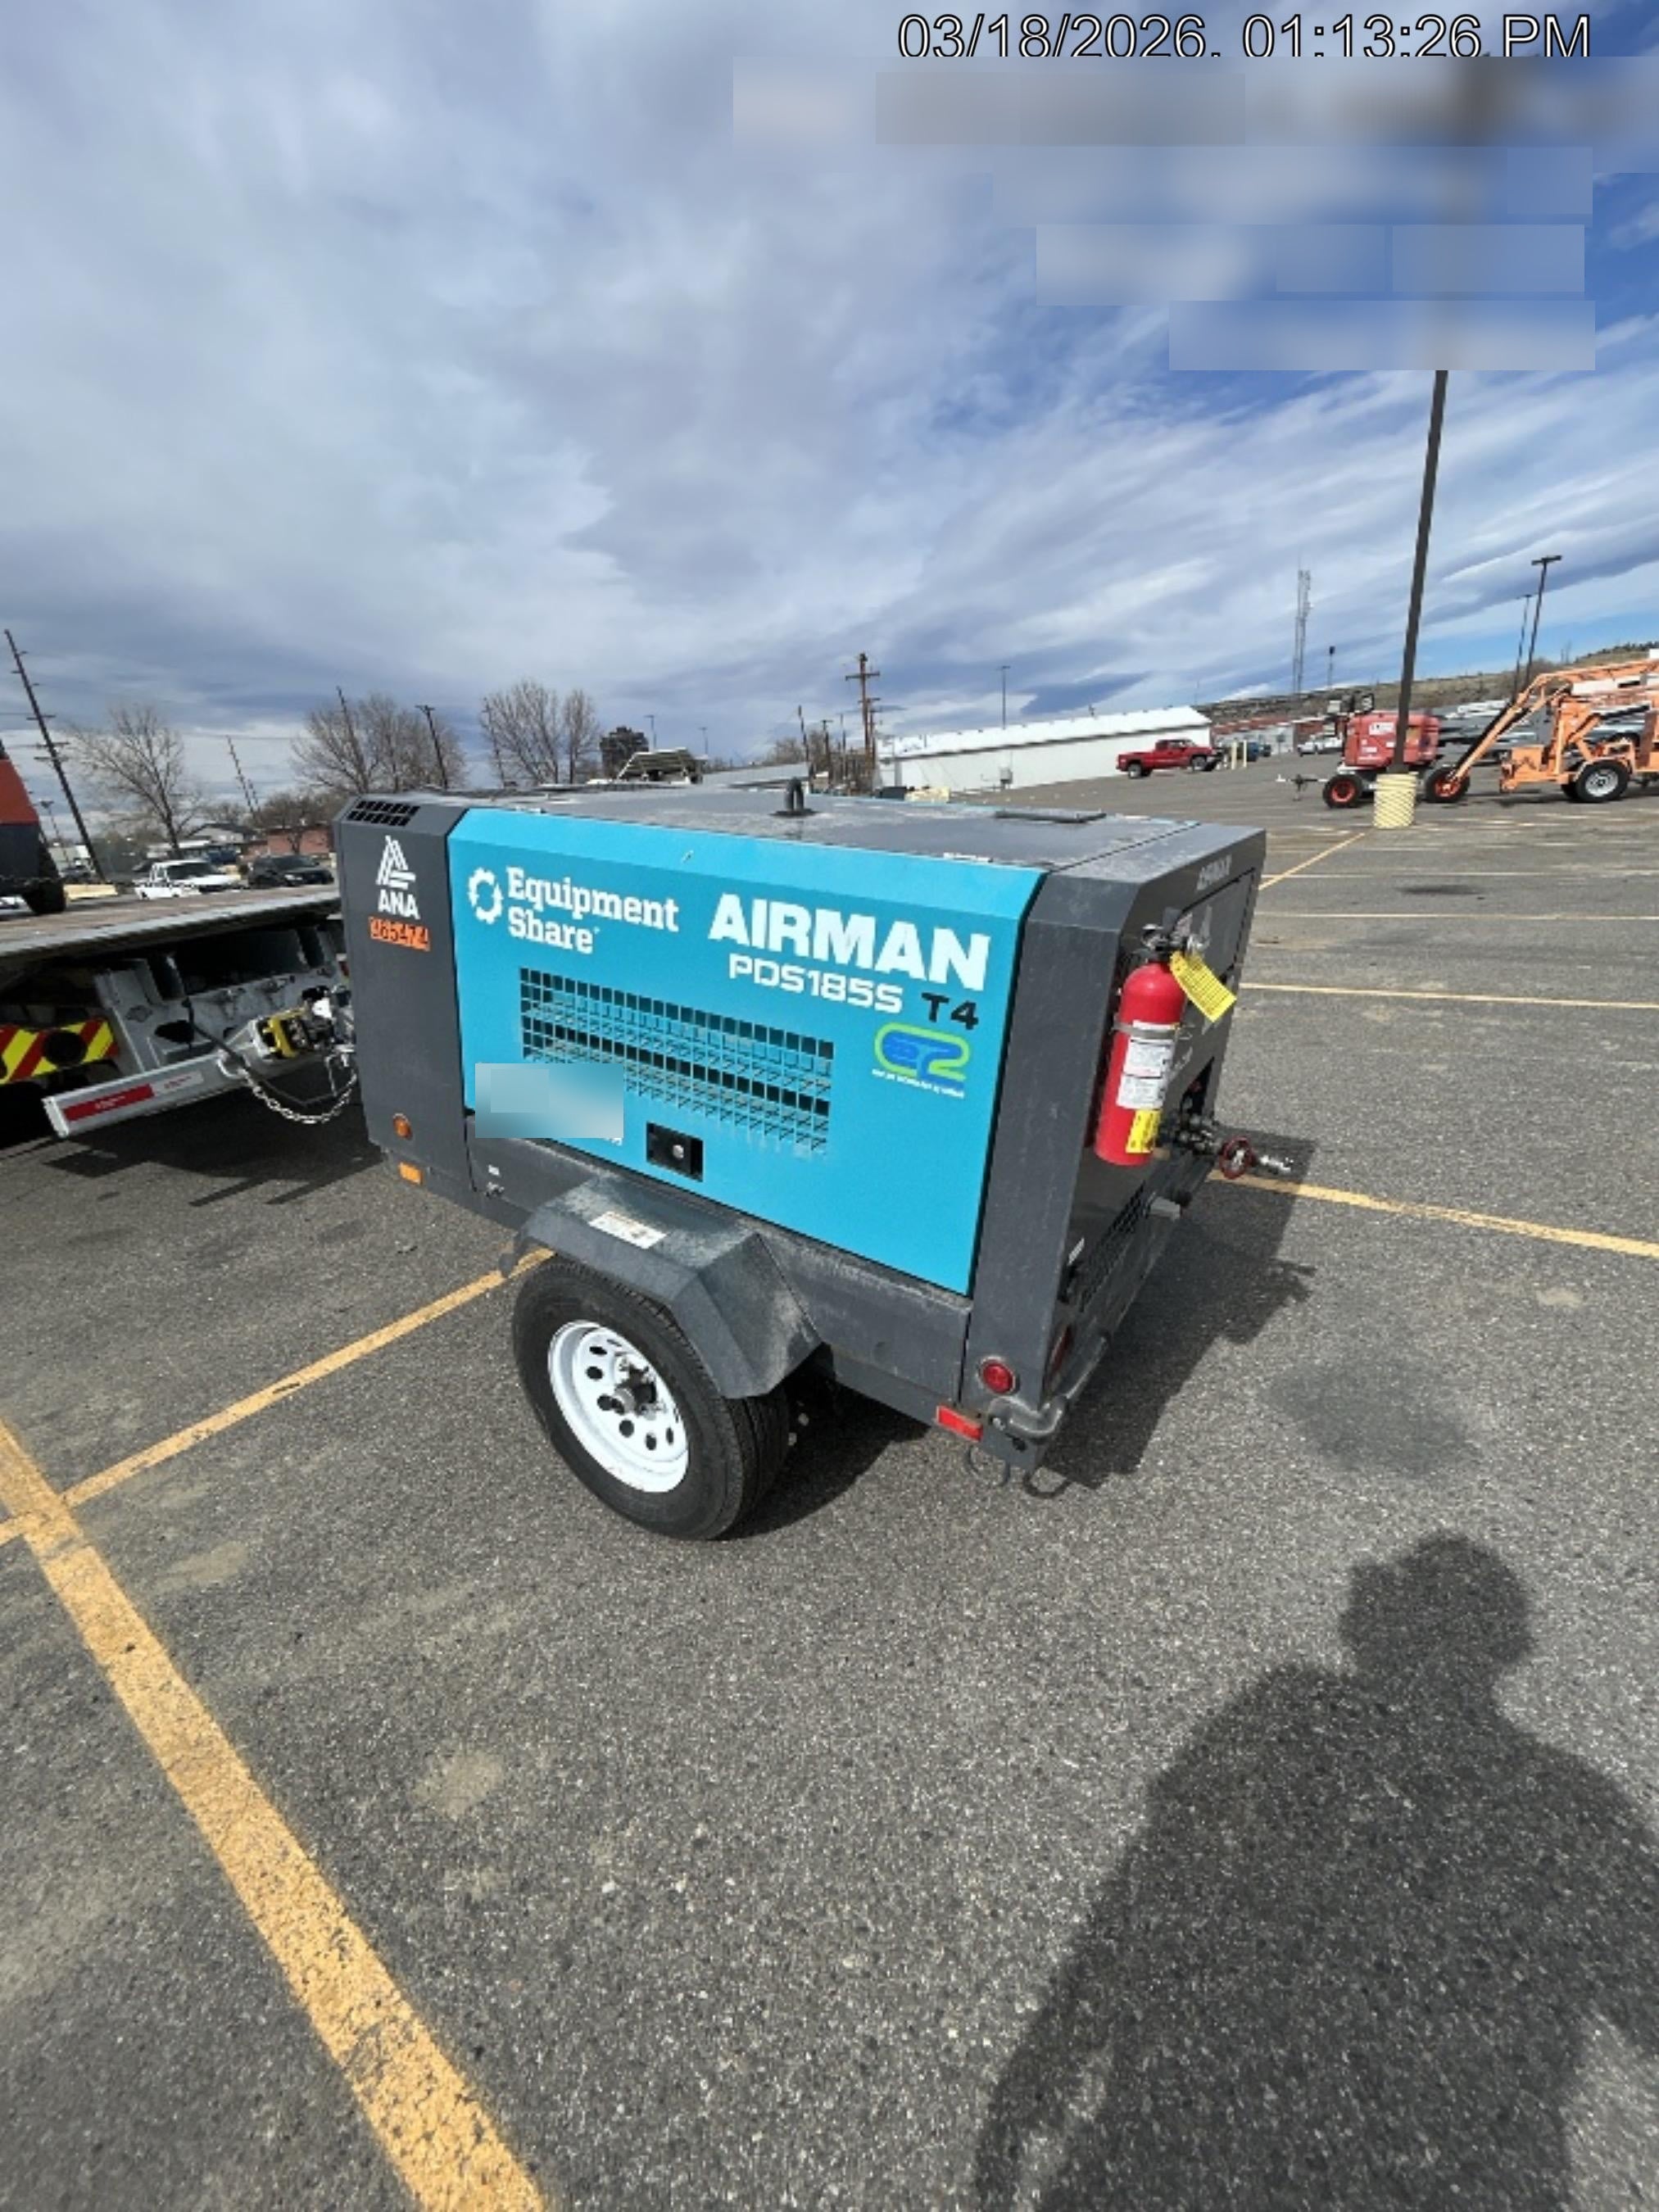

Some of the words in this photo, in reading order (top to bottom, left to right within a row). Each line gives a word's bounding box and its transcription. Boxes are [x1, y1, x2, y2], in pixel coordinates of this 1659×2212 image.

[378, 889, 420, 920] ANA
[505, 865, 679, 932] Equipment
[508, 905, 593, 955] Share
[707, 892, 991, 991] AIRMAN
[728, 953, 903, 1014] PDS185S
[921, 991, 980, 1031] T4
